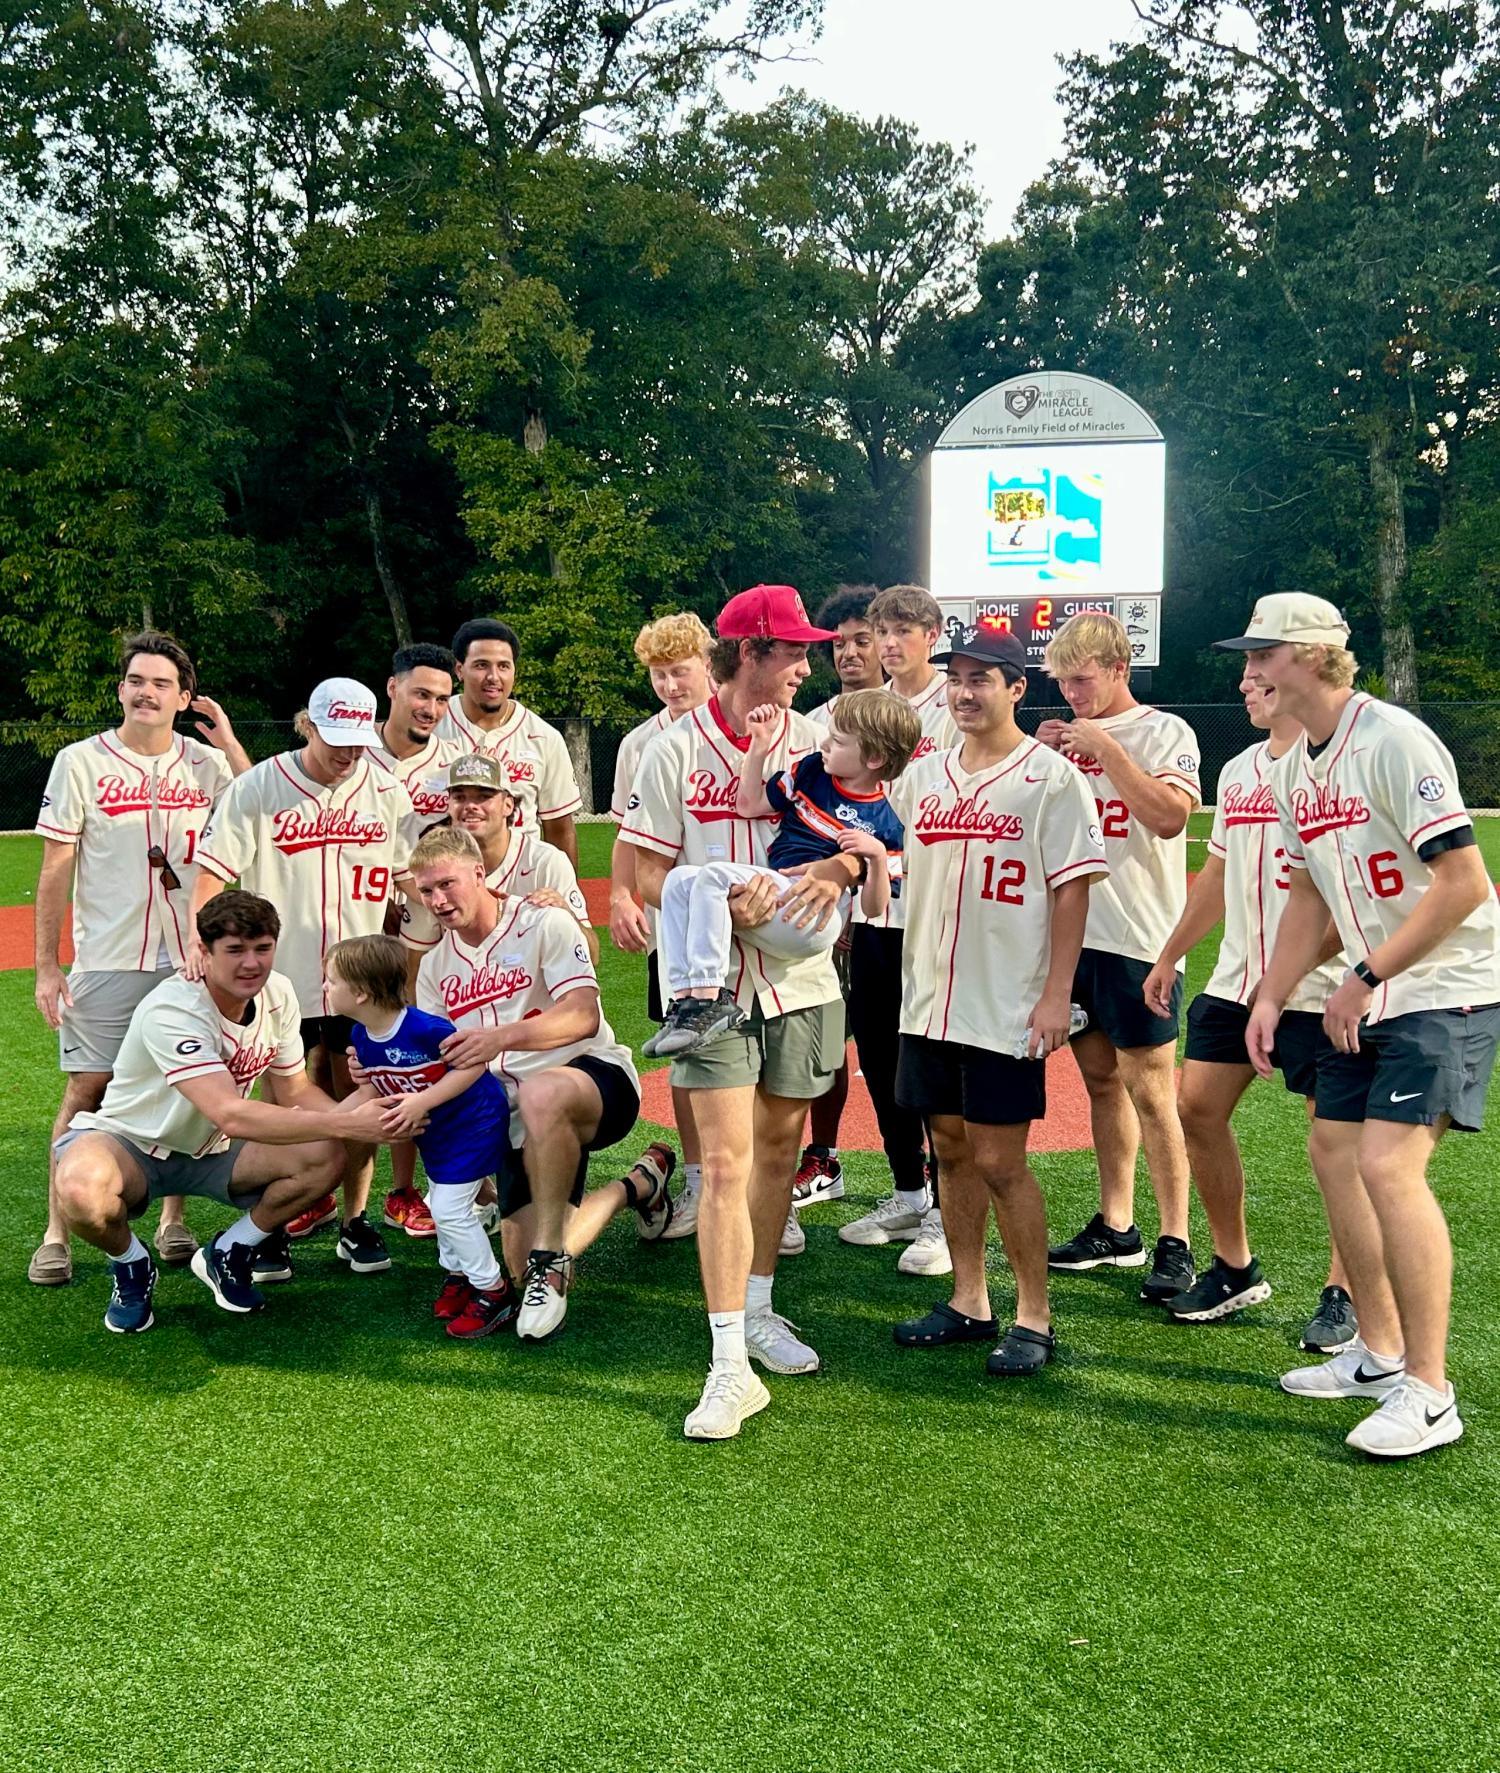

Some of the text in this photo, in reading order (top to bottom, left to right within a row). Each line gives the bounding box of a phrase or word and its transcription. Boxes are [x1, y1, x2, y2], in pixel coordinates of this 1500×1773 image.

[1038, 397, 1088, 408] MIRACLE
[1053, 407, 1093, 418] LEAGUE
[973, 421, 1125, 436] Norris Family Field of Miracles
[976, 603, 1019, 617] HOME
[1036, 599, 1052, 627] 2
[1064, 602, 1114, 616] GUEST
[1031, 629, 1055, 641] INN
[1027, 646, 1045, 656] STR
[328, 701, 373, 727] Georgi
[1223, 783, 1278, 815] Bulld
[1420, 779, 1444, 800] SEC
[1290, 784, 1370, 828] Bulldgs
[273, 808, 387, 847] Bulldogs
[914, 795, 1024, 844] Bulldogs
[352, 865, 389, 902] 19
[981, 855, 1026, 906] 12
[440, 963, 532, 1007] Bulldogs
[176, 1039, 201, 1055] G
